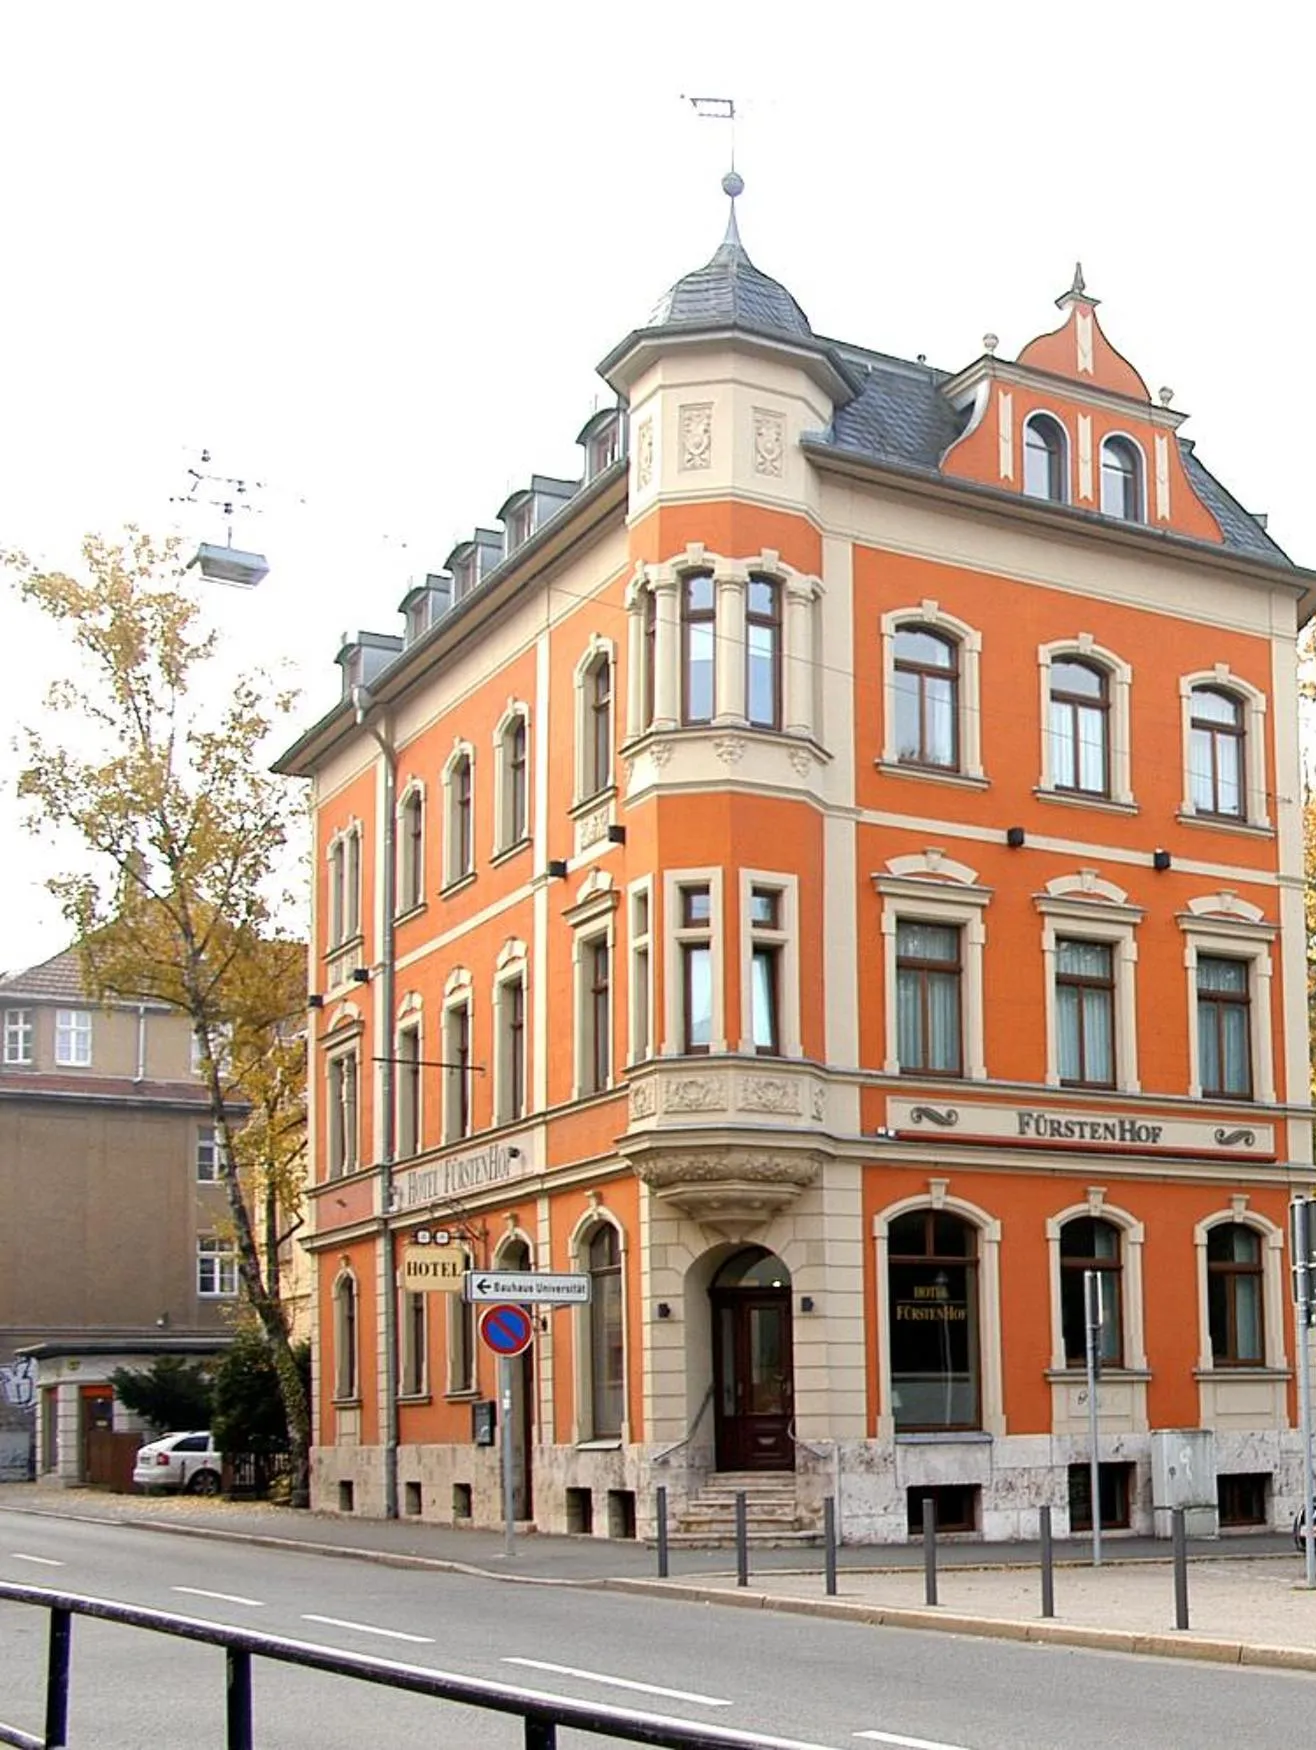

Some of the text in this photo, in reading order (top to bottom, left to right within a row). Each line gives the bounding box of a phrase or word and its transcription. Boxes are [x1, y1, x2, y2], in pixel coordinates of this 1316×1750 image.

[1017, 1112, 1163, 1143] FÜRSTENHOF
[407, 1261, 461, 1277] HOTEL
[494, 1282, 585, 1294] Bauhaus Universität
